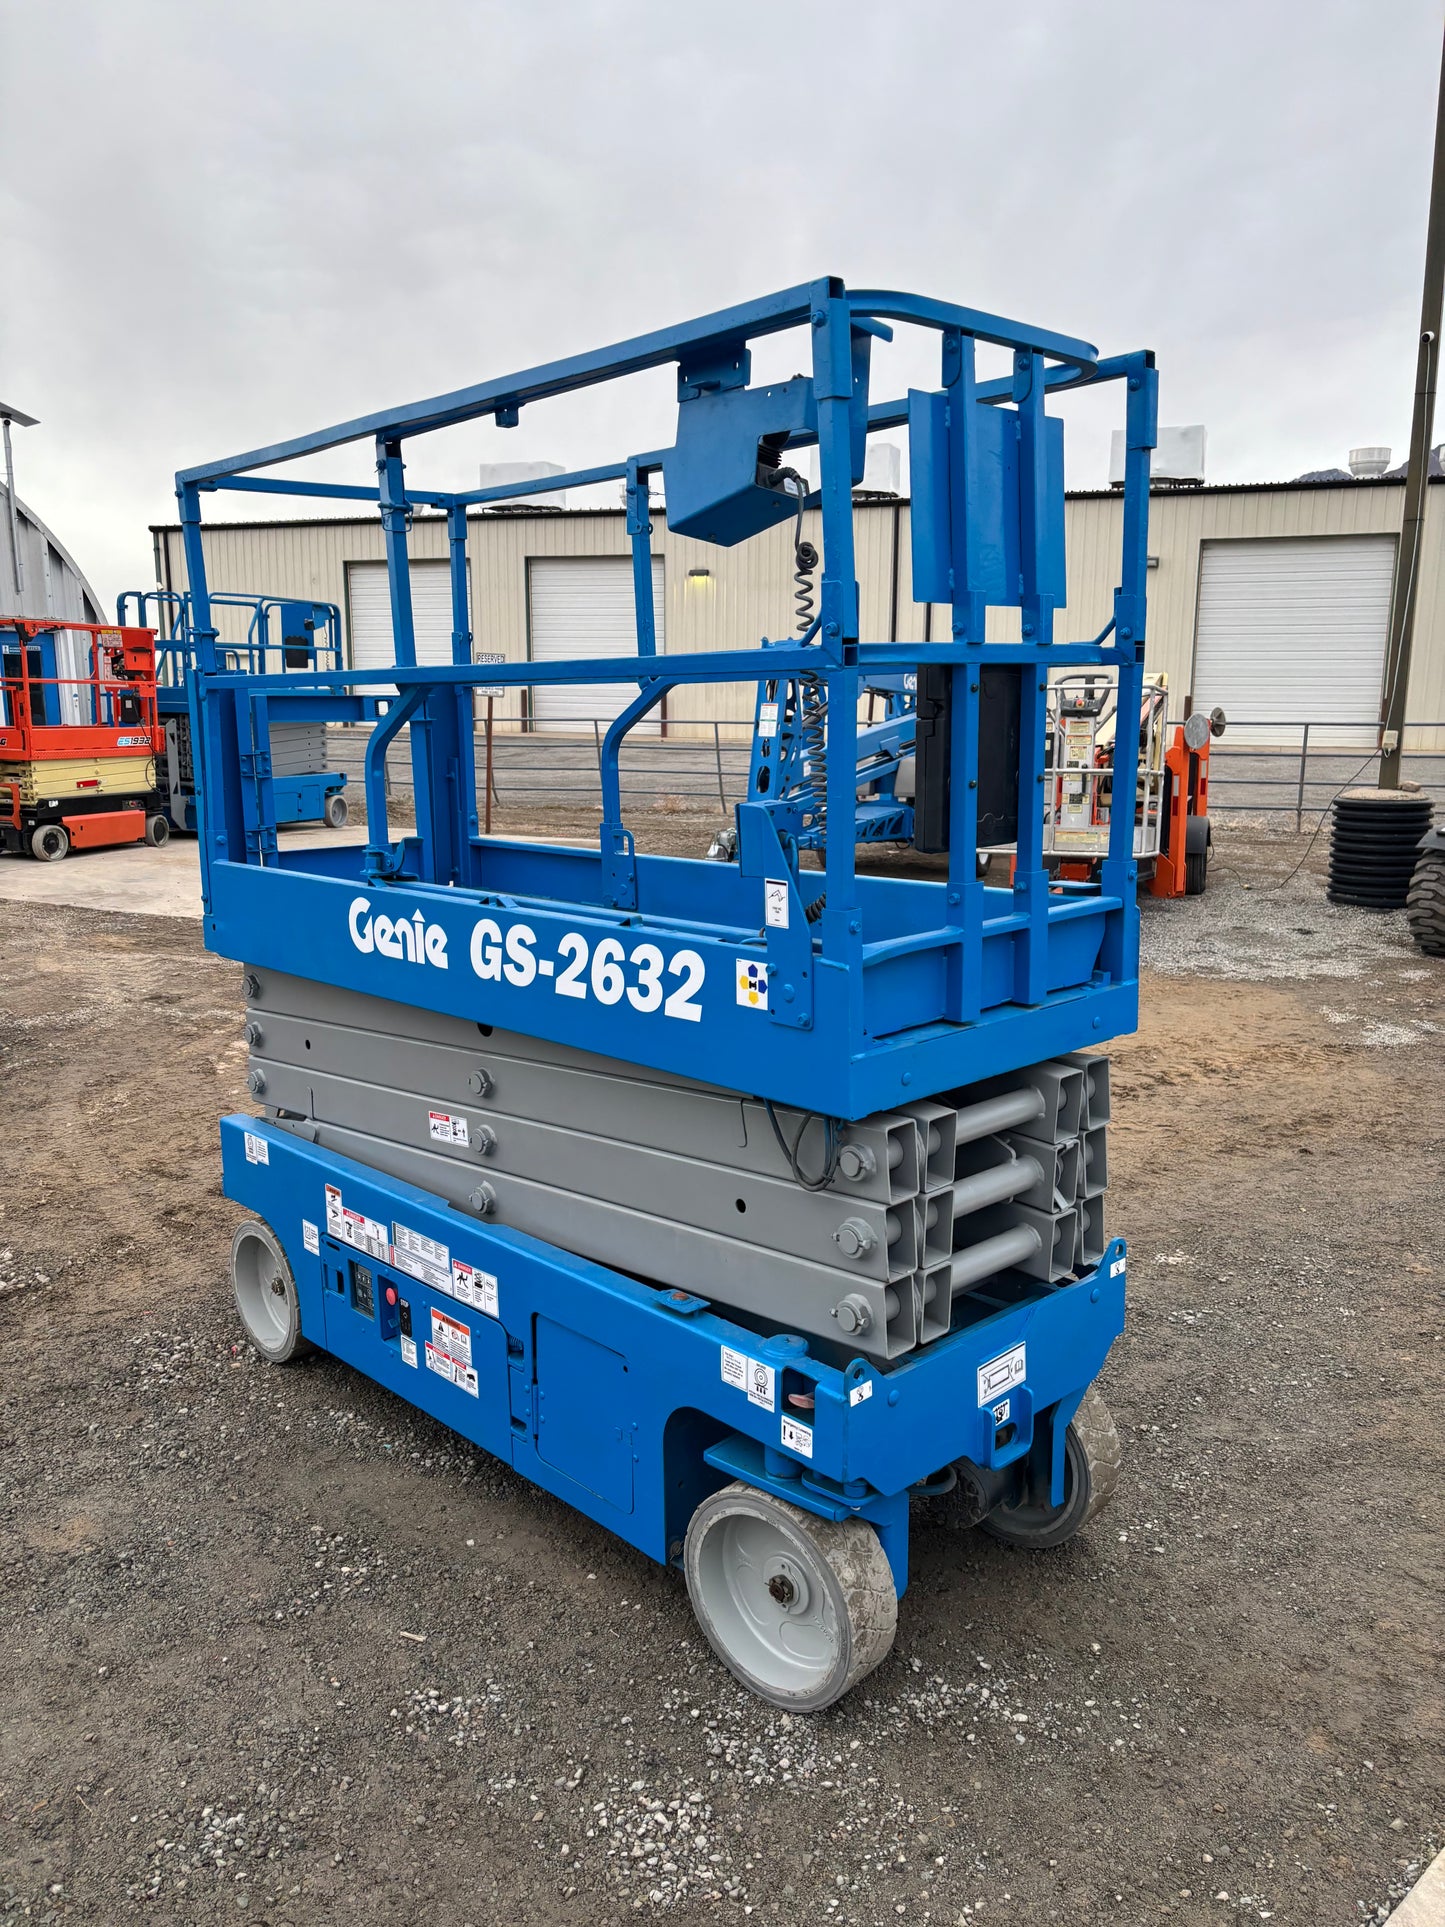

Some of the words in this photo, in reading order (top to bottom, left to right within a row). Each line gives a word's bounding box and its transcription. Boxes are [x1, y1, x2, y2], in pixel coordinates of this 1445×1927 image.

[477, 654, 505, 664] RESERVED
[349, 897, 448, 969] Genie
[471, 918, 706, 1023] GS-2632
[457, 1262, 472, 1273] DANGER
[400, 1298, 409, 1308] STOP
